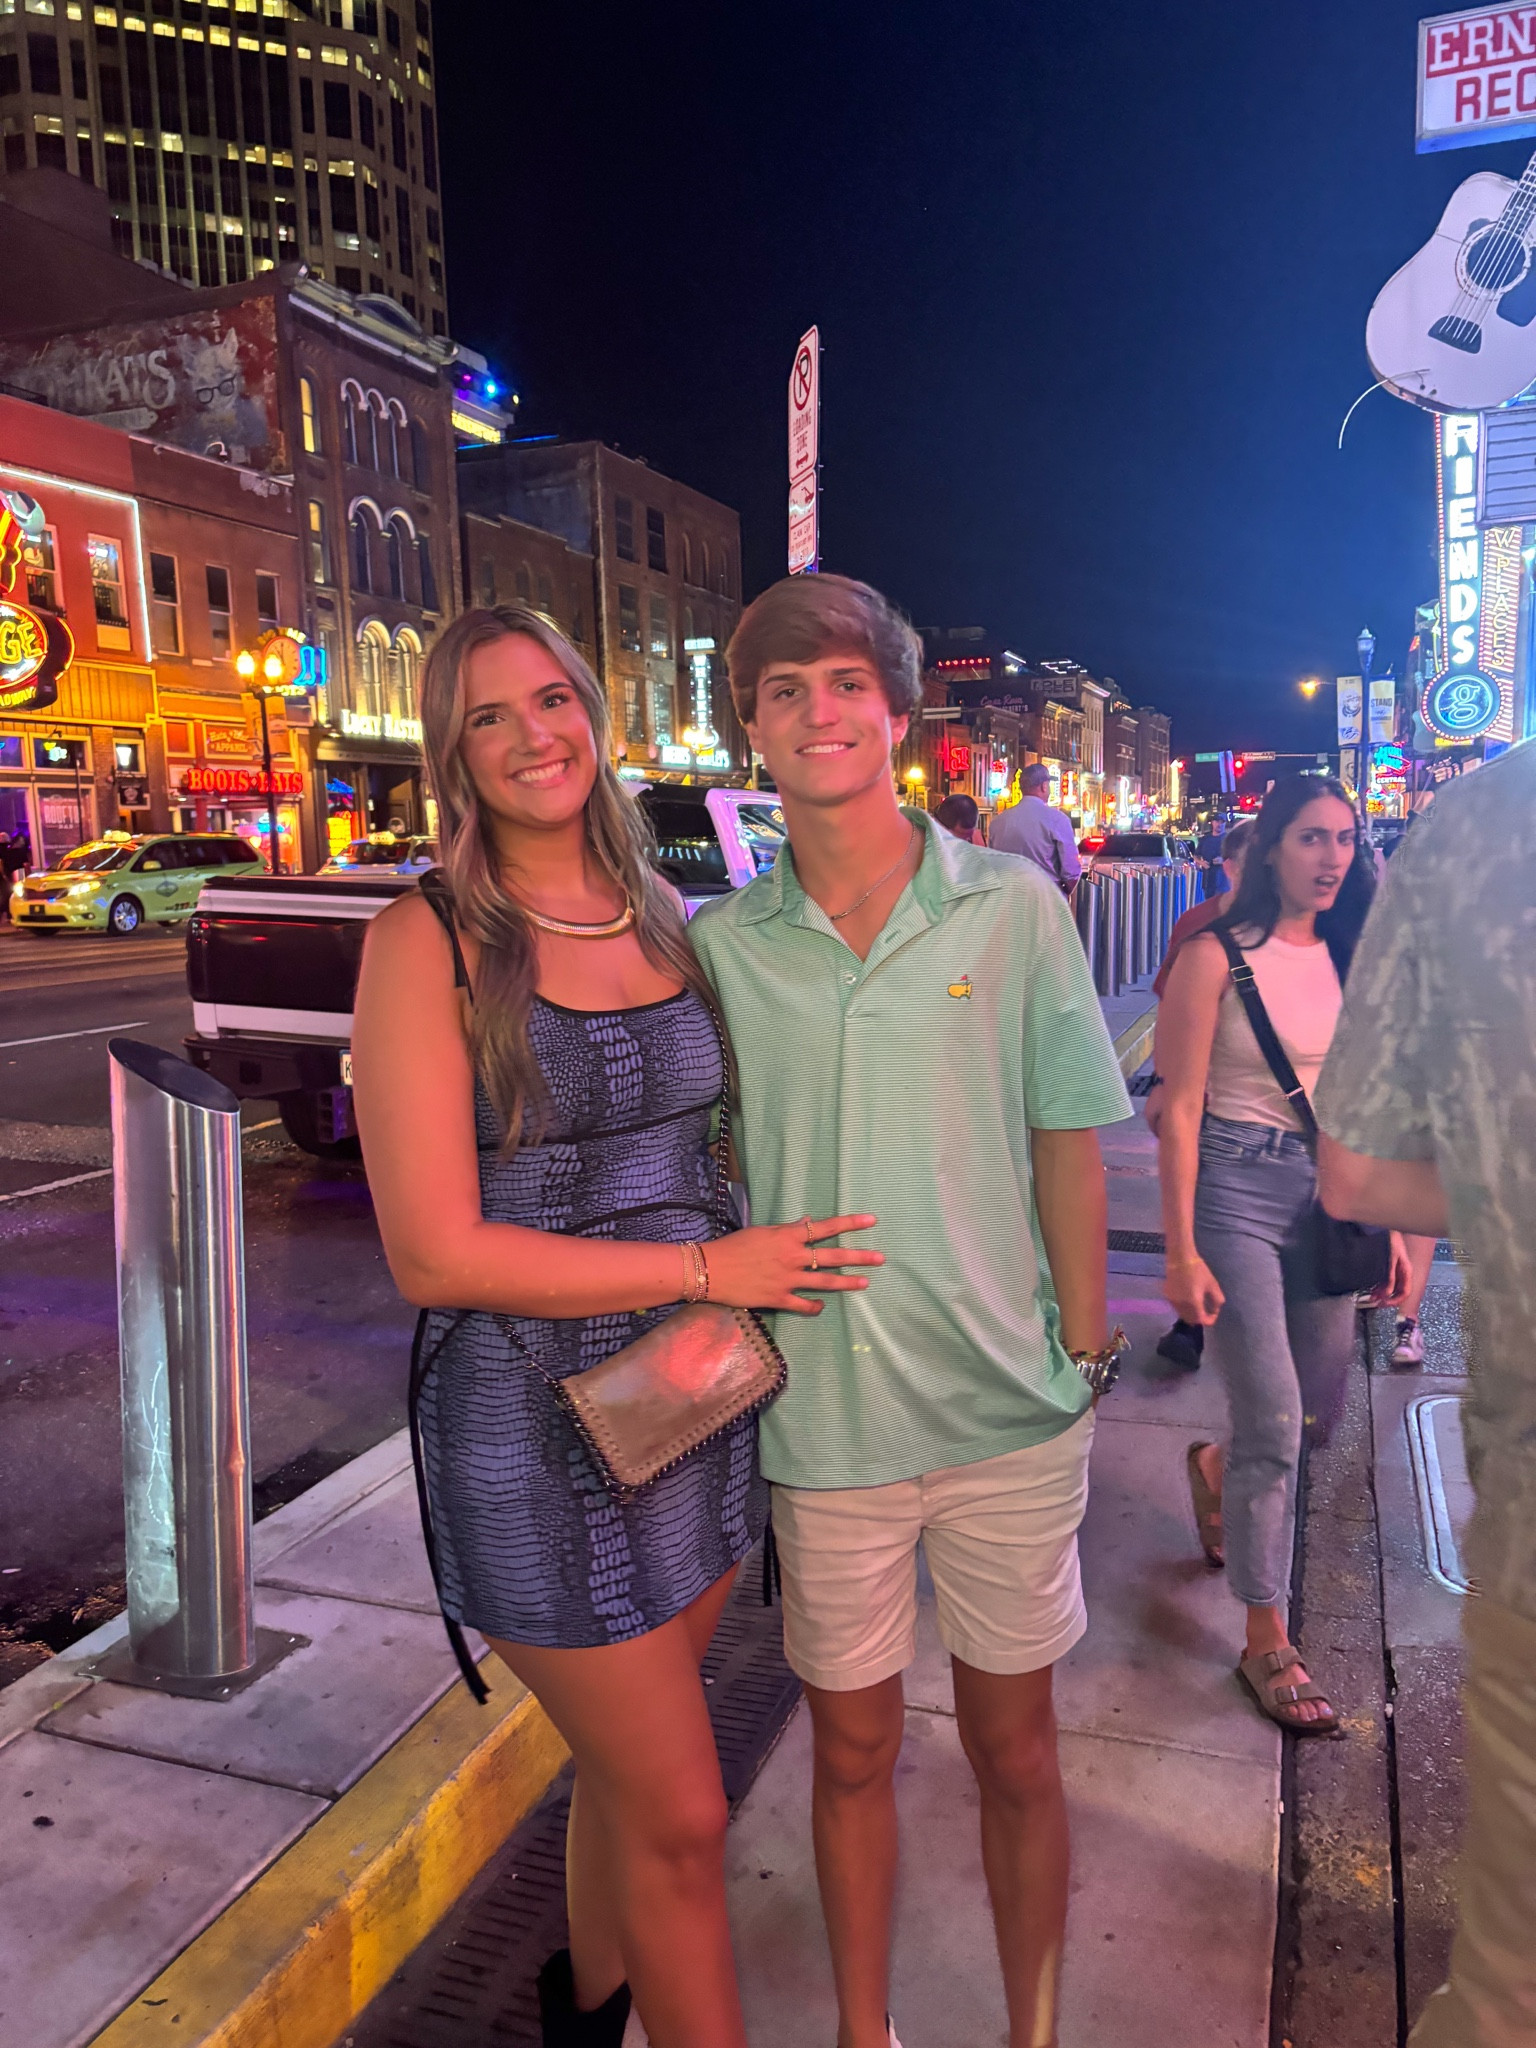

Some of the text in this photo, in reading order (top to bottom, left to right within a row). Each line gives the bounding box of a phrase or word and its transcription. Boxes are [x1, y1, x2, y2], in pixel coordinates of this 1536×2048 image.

[793, 407, 812, 437] LOADING
[797, 430, 808, 453] ZONE
[1490, 555, 1512, 668] PLACES
[0, 620, 43, 664] GE
[937, 657, 991, 667] LOOKOUT
[1371, 698, 1393, 707] STAND
[341, 708, 381, 736] LUCKY
[187, 768, 250, 792] BOOTS
[1376, 776, 1407, 784] CENTRAL
